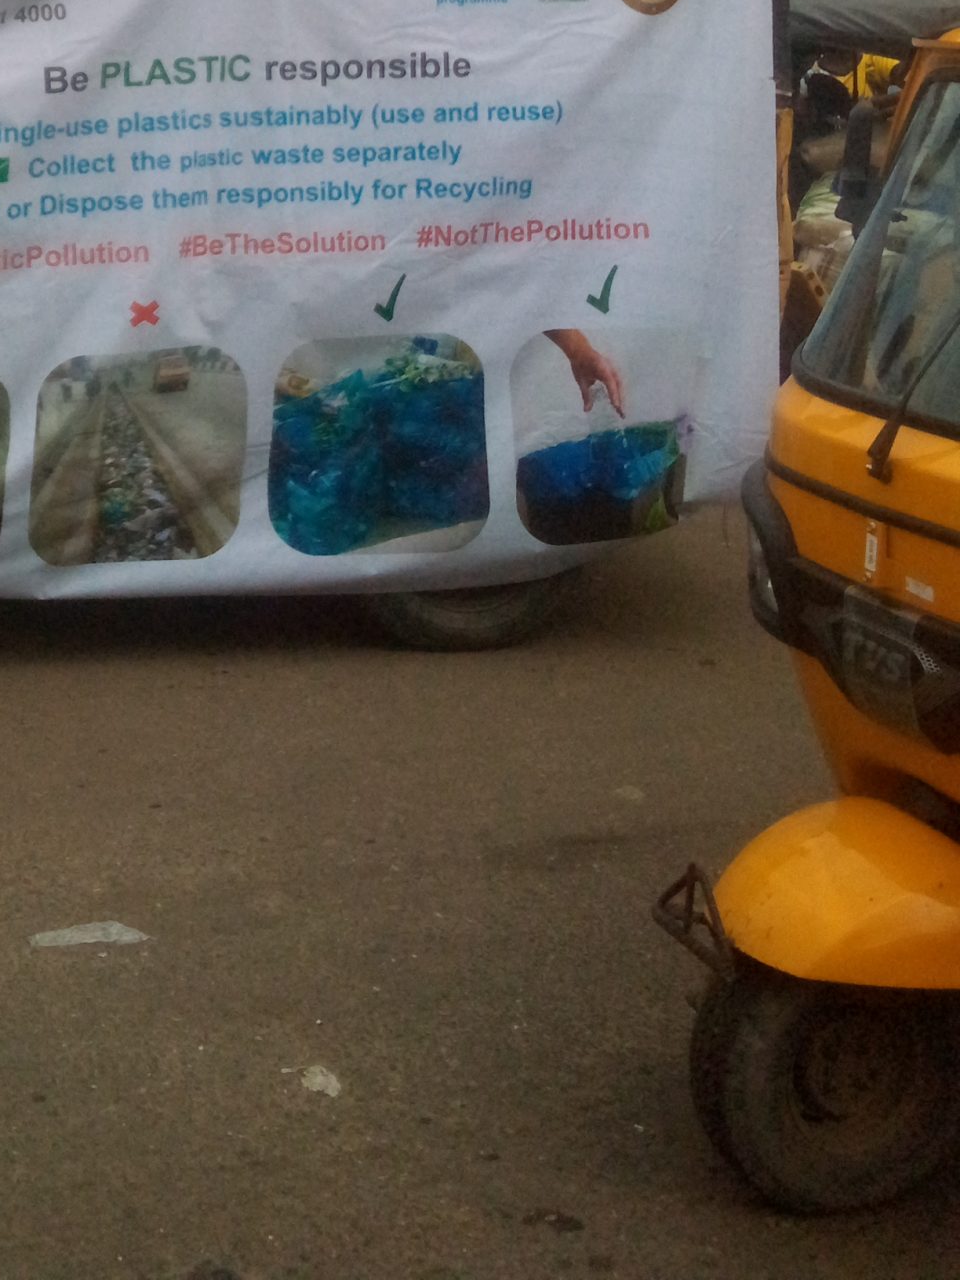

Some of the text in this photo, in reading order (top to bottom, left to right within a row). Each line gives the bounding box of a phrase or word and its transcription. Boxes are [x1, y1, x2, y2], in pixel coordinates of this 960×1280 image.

[14, 3, 67, 23] 4000
[44, 52, 472, 94] Be PLASTIC responsible
[117, 108, 213, 138] plastics
[219, 103, 363, 130] sustainably
[371, 102, 428, 129] (use
[433, 101, 479, 123] and
[487, 99, 564, 125] reuse)
[28, 140, 463, 179] Collect the plastic waste separately
[7, 201, 32, 220] or
[40, 191, 144, 220] Dispose
[152, 187, 208, 211] them
[216, 178, 365, 207] responsibly
[372, 177, 407, 201] for
[415, 176, 533, 203] Recycling
[178, 230, 386, 259] #BeTheSolution
[415, 217, 651, 249] #NotThePollution
